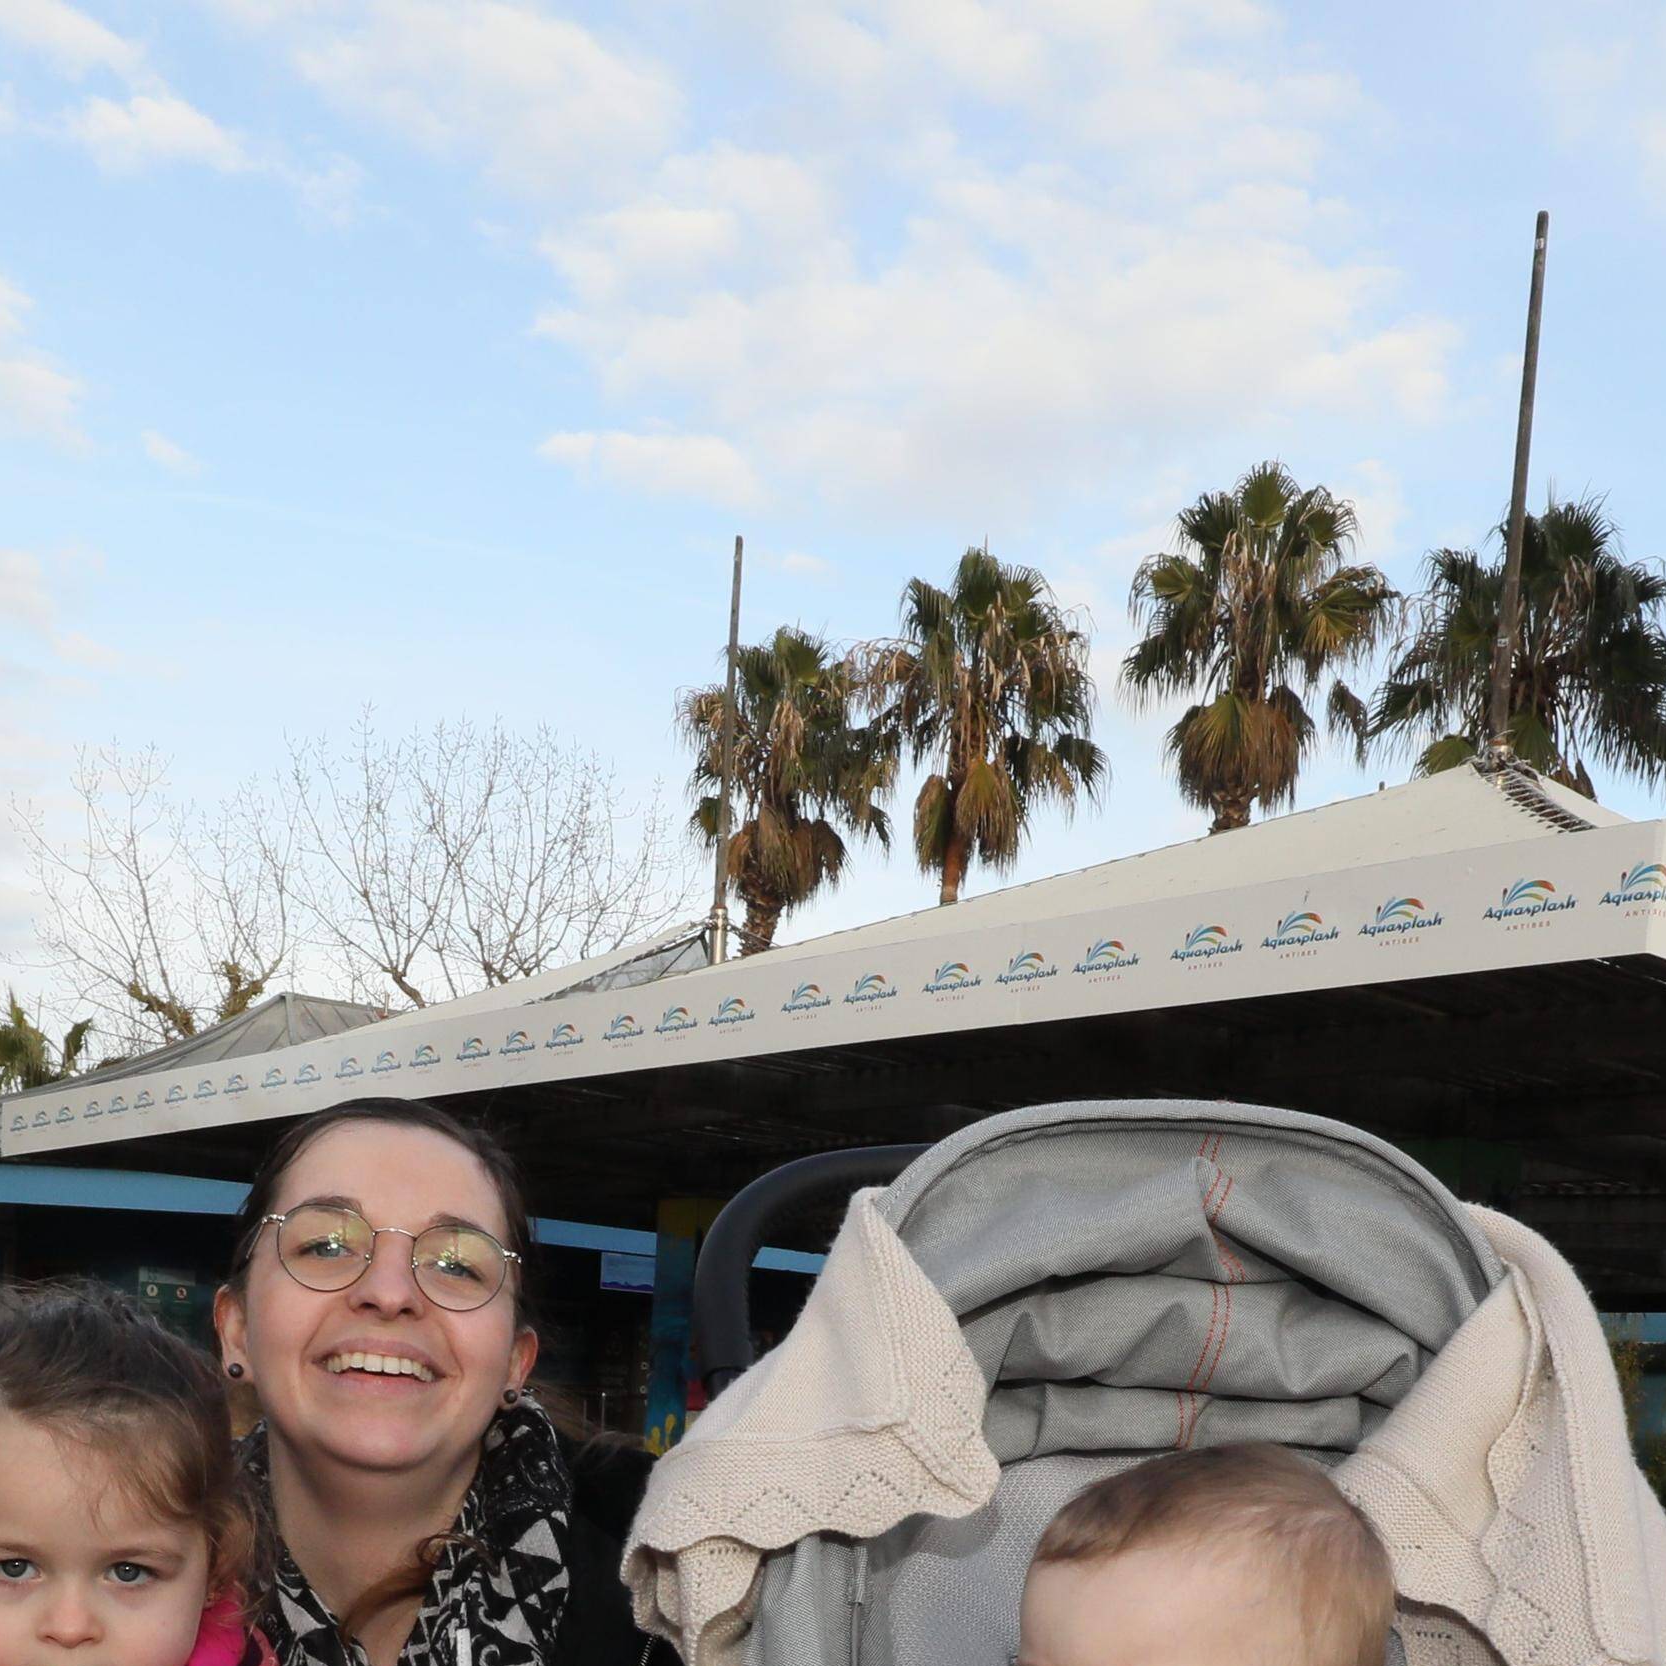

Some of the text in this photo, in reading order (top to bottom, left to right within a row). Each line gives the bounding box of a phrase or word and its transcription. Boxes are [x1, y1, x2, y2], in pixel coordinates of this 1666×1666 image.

[1482, 895, 1578, 922] Aquasplash
[1357, 912, 1445, 938] Aquasplash
[1506, 921, 1551, 931] ANTIBES
[1260, 926, 1341, 950] Aquasplash
[1379, 936, 1420, 947] ANTIBES
[1170, 939, 1244, 961] Aquasplash
